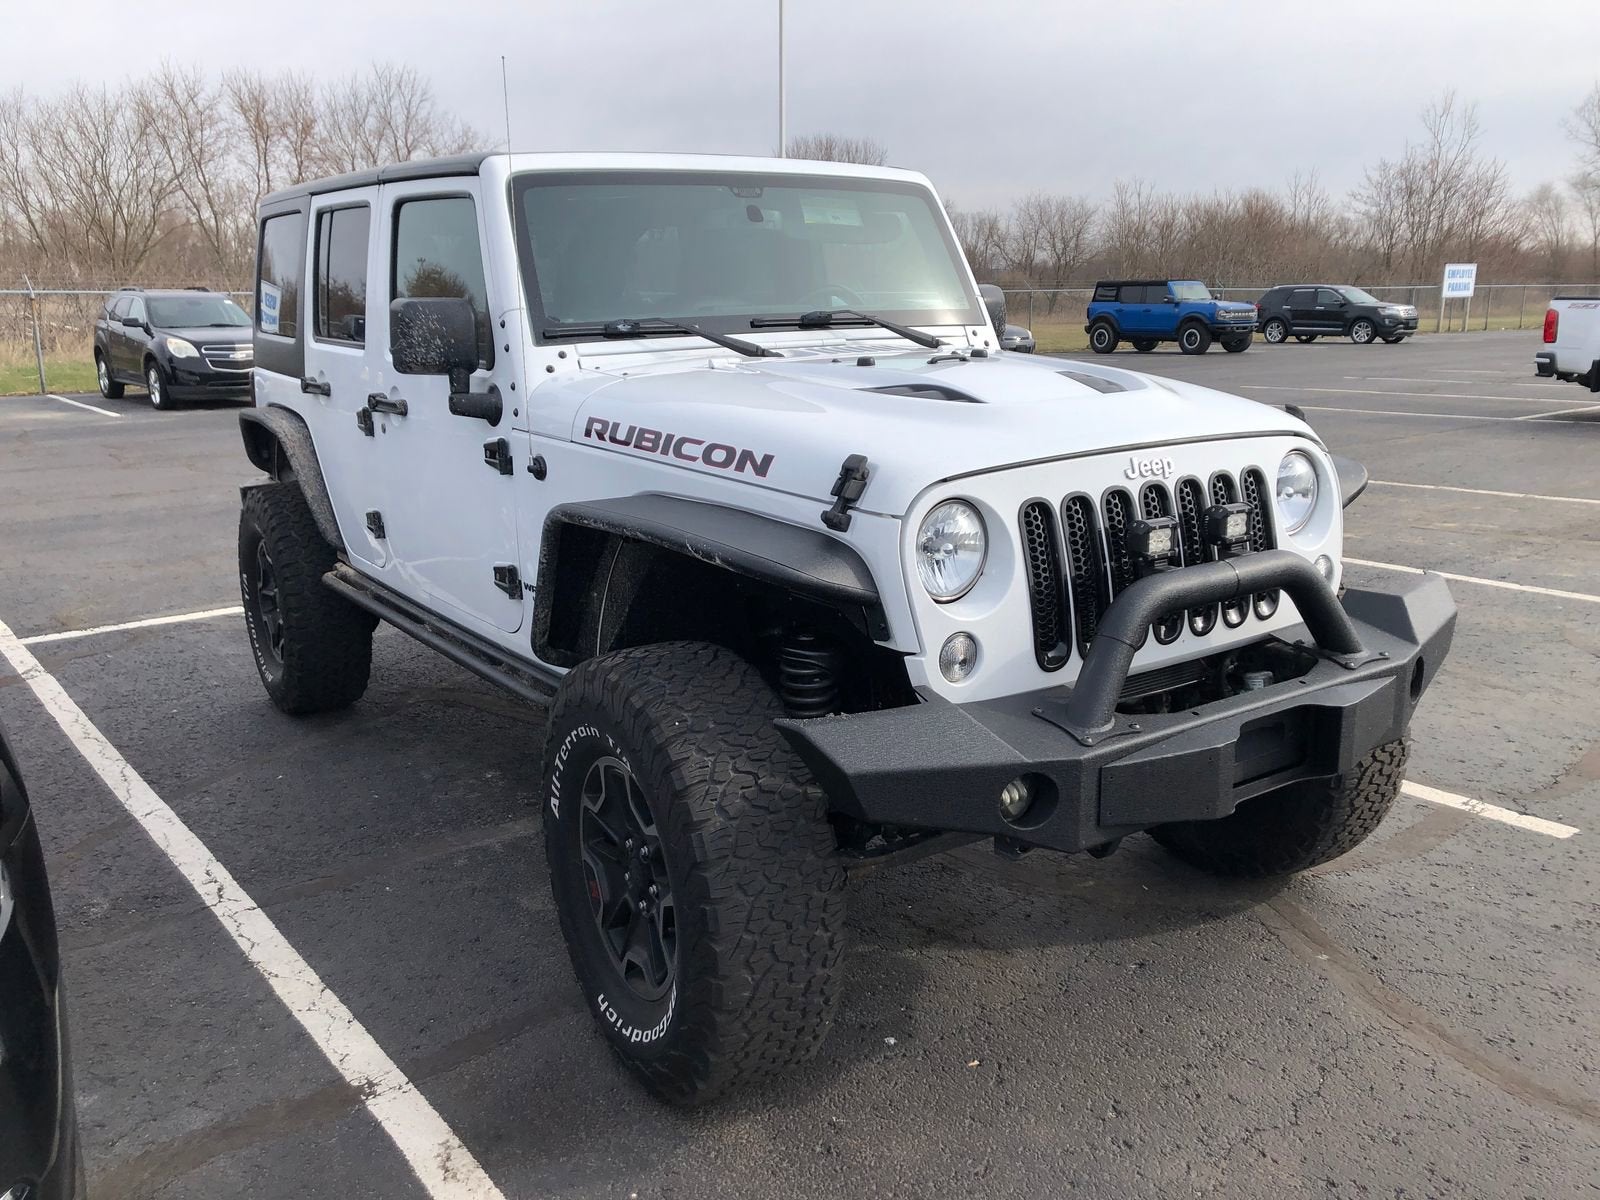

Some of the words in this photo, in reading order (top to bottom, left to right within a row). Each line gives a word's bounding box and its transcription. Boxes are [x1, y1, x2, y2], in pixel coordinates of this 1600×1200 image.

[1448, 269, 1473, 278] EMPLOYEE
[1448, 282, 1471, 291] PARKING
[583, 416, 776, 478] RUBICON
[1123, 456, 1173, 480] Jeep
[550, 723, 601, 820] All-Terrain
